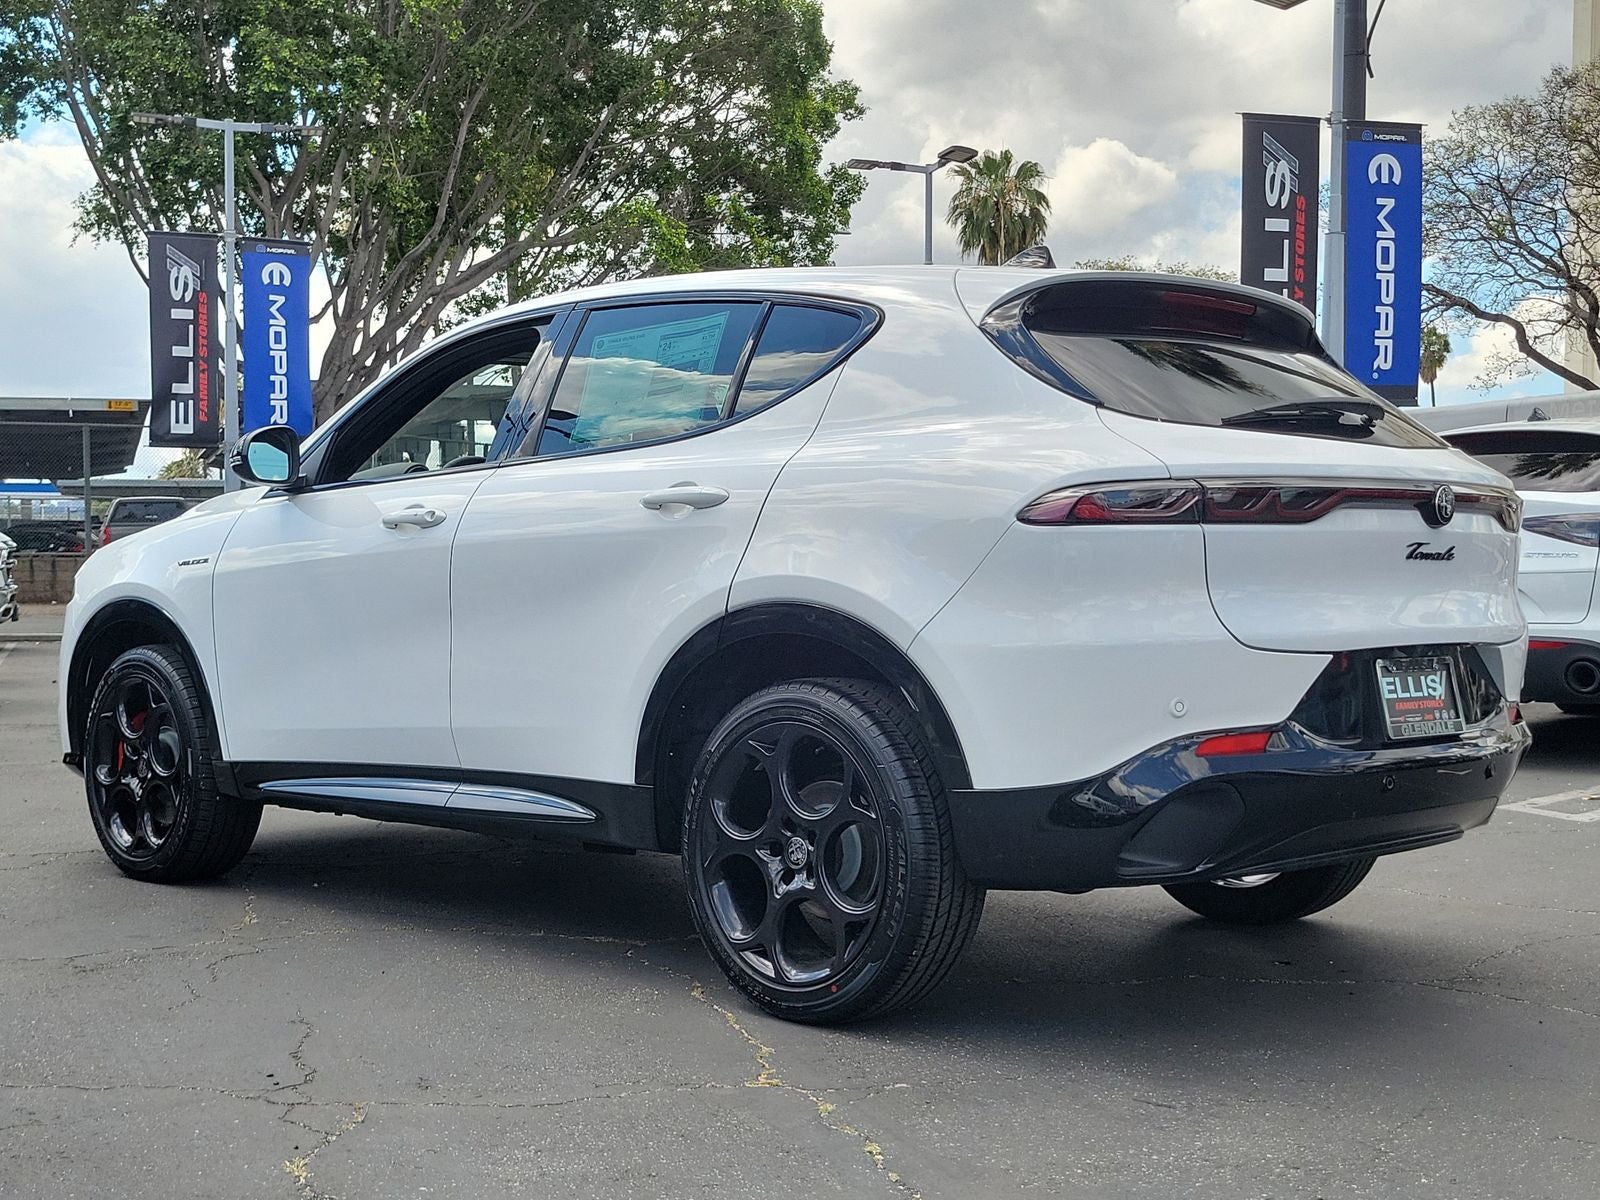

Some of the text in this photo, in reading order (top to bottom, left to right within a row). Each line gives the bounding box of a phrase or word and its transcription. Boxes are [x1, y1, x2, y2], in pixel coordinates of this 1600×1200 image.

[1294, 194, 1306, 283] STORES
[169, 264, 195, 435] ELLIS
[197, 291, 209, 422] FAMILY STORES
[268, 294, 289, 425] MOPAR
[1405, 541, 1456, 561] Tonale
[1381, 675, 1443, 699] ELLIS
[1395, 700, 1445, 710] FAMILY STORES
[1401, 721, 1456, 736] GLENDALE
